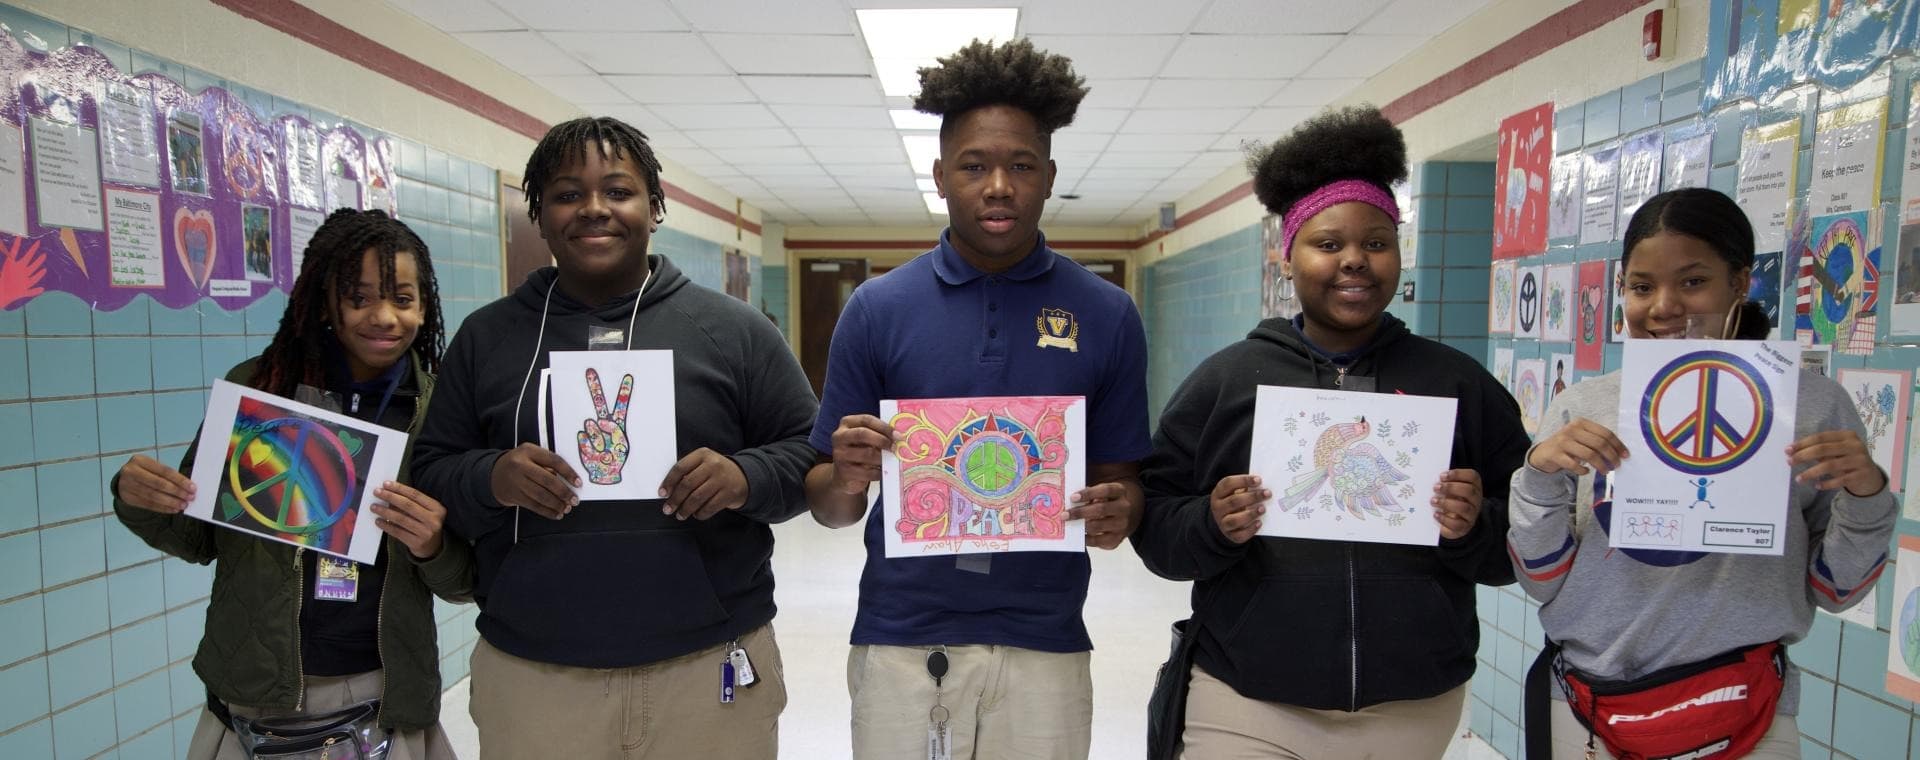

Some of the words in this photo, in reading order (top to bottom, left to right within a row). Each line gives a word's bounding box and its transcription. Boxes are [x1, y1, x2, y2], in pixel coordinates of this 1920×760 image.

[1821, 168, 1834, 180] Keep
[1836, 166, 1845, 176] the
[1846, 163, 1864, 177] peace
[123, 198, 142, 209] Baltimore
[143, 201, 152, 211] City
[1047, 316, 1068, 336] V
[1760, 342, 1771, 352] The
[948, 486, 1034, 537] PEACE
[1710, 525, 1744, 533] Clarence
[1747, 527, 1770, 535] Taylor
